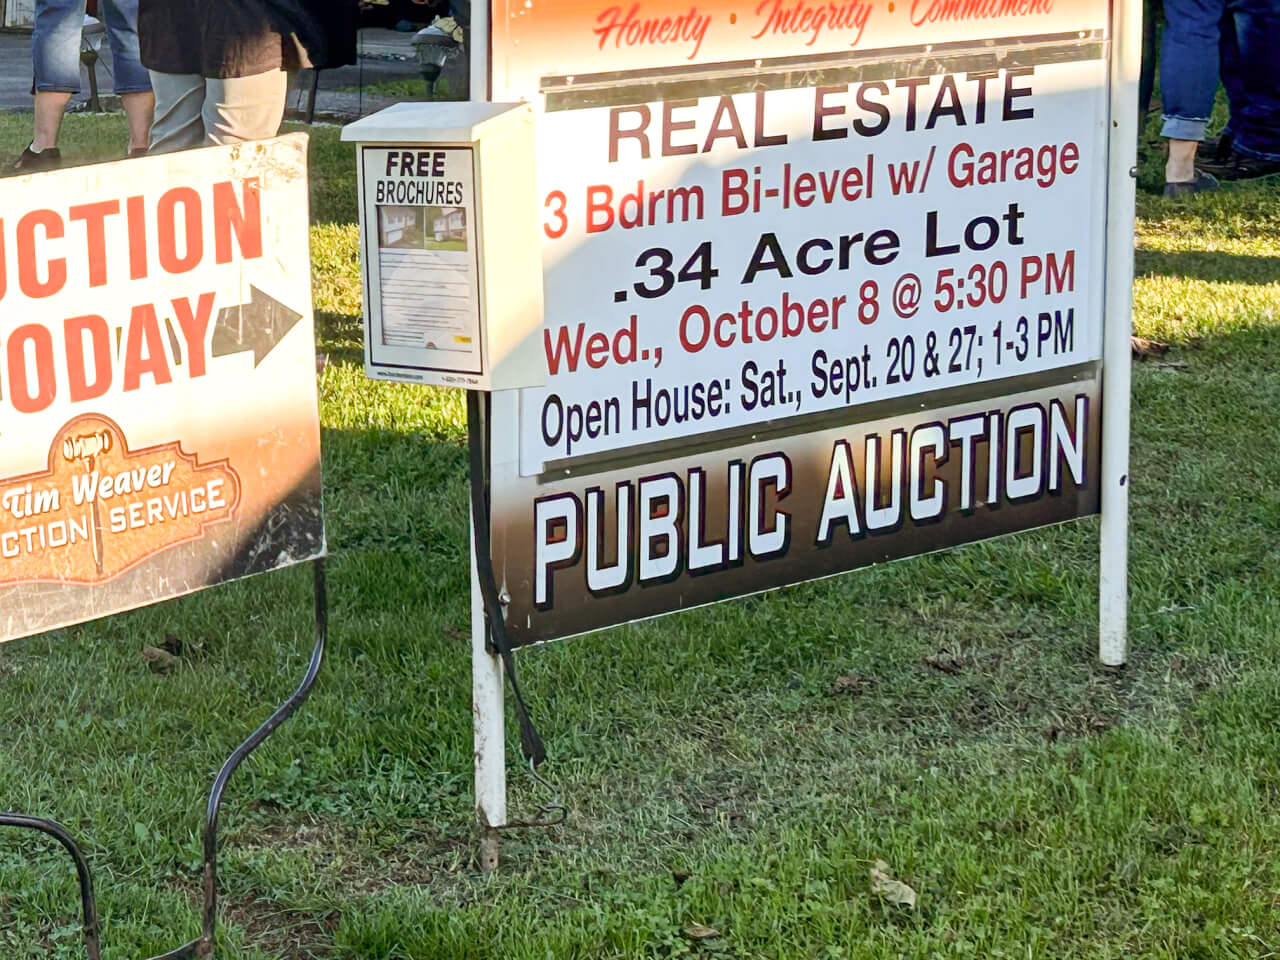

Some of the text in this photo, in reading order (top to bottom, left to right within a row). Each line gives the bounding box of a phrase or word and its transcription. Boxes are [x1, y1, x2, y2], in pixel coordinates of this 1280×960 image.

[594, 4, 711, 58] Honesty
[608, 69, 1034, 162] REAL ESTATE
[376, 180, 463, 204] BROCHURES
[386, 151, 446, 177] FREE
[543, 141, 1079, 239] 3 Bdrm Bi-level w/ Garage
[615, 203, 1024, 302] .34 Acre Lot
[544, 250, 1075, 375] Wed., October 8 @ 5:30 PM
[542, 309, 1074, 453] Open House: Sat., Sept. 20 & 27; 1-3 PM
[3, 460, 175, 519] Tim Weaver
[110, 479, 226, 532] SERVICE
[533, 393, 1089, 608] PUBLIC AUCTION
